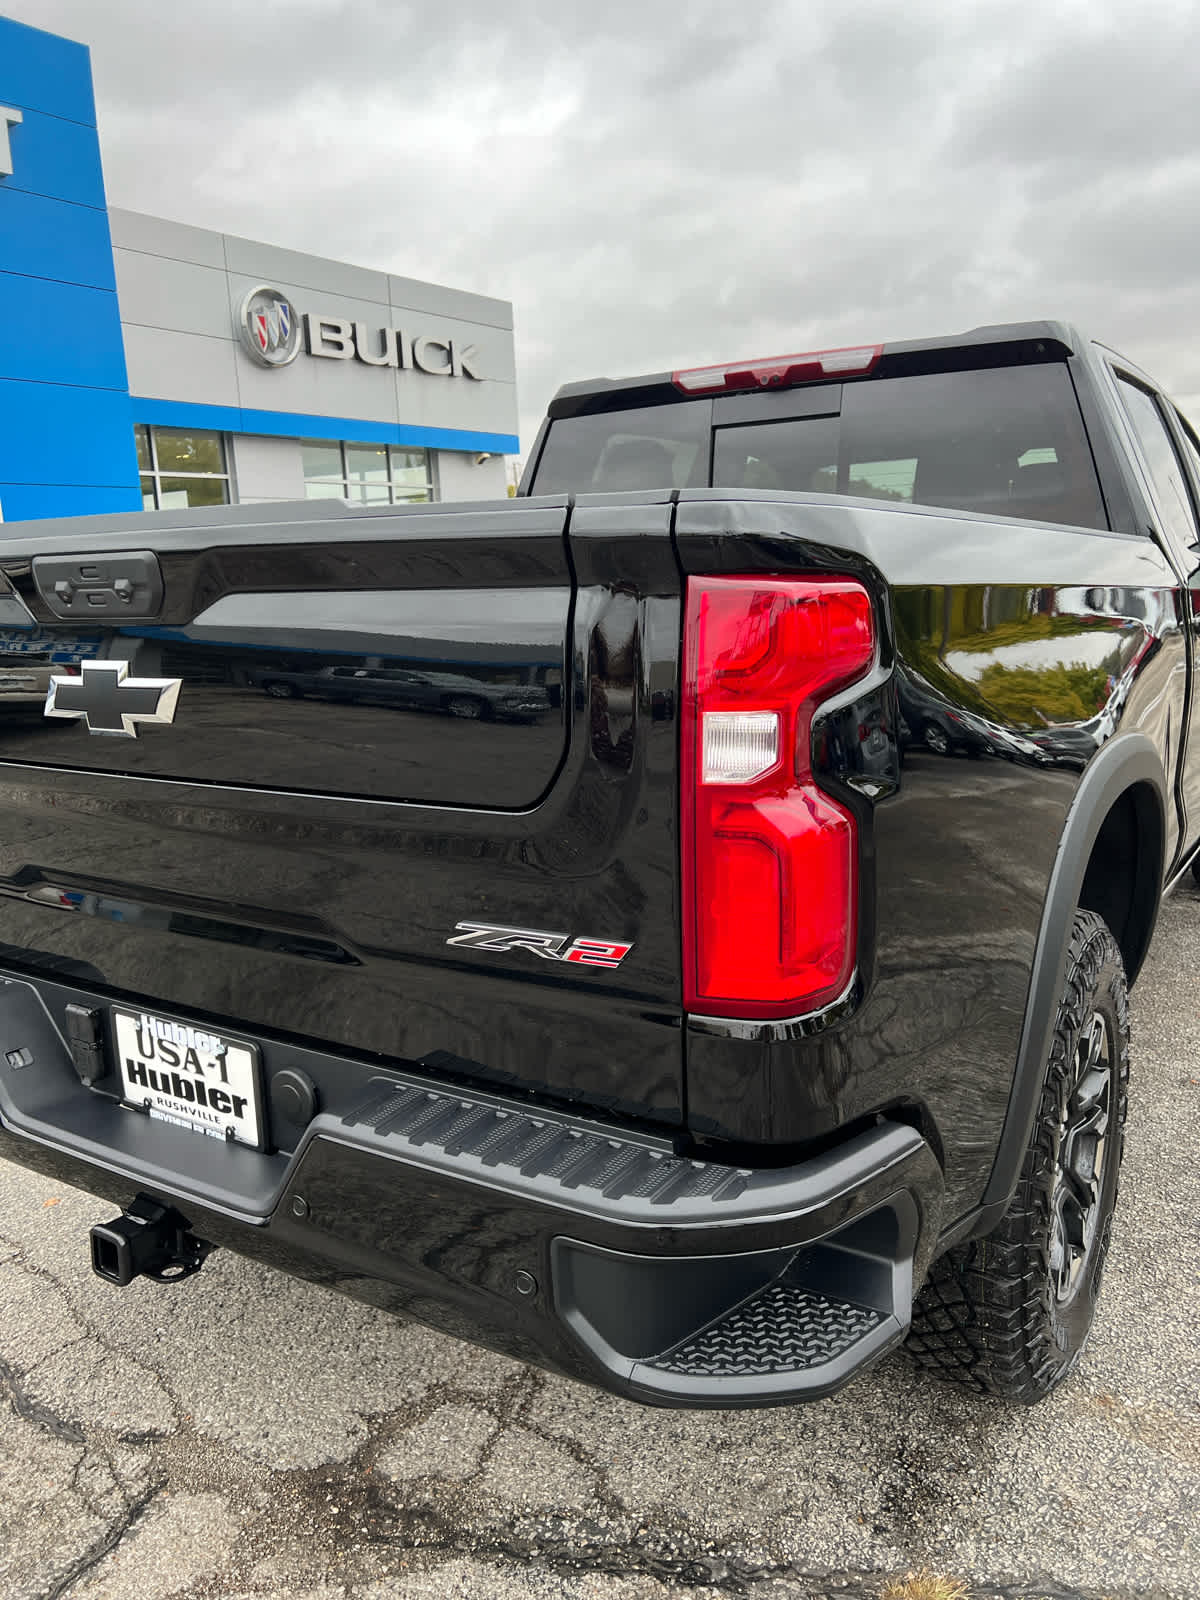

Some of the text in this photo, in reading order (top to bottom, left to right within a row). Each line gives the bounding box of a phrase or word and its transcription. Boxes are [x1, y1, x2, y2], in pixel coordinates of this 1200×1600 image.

[303, 312, 485, 382] BUICK
[446, 920, 635, 969] ZR2
[126, 1058, 248, 1119] Hubler
[156, 1096, 222, 1125] RUSHVILLE
